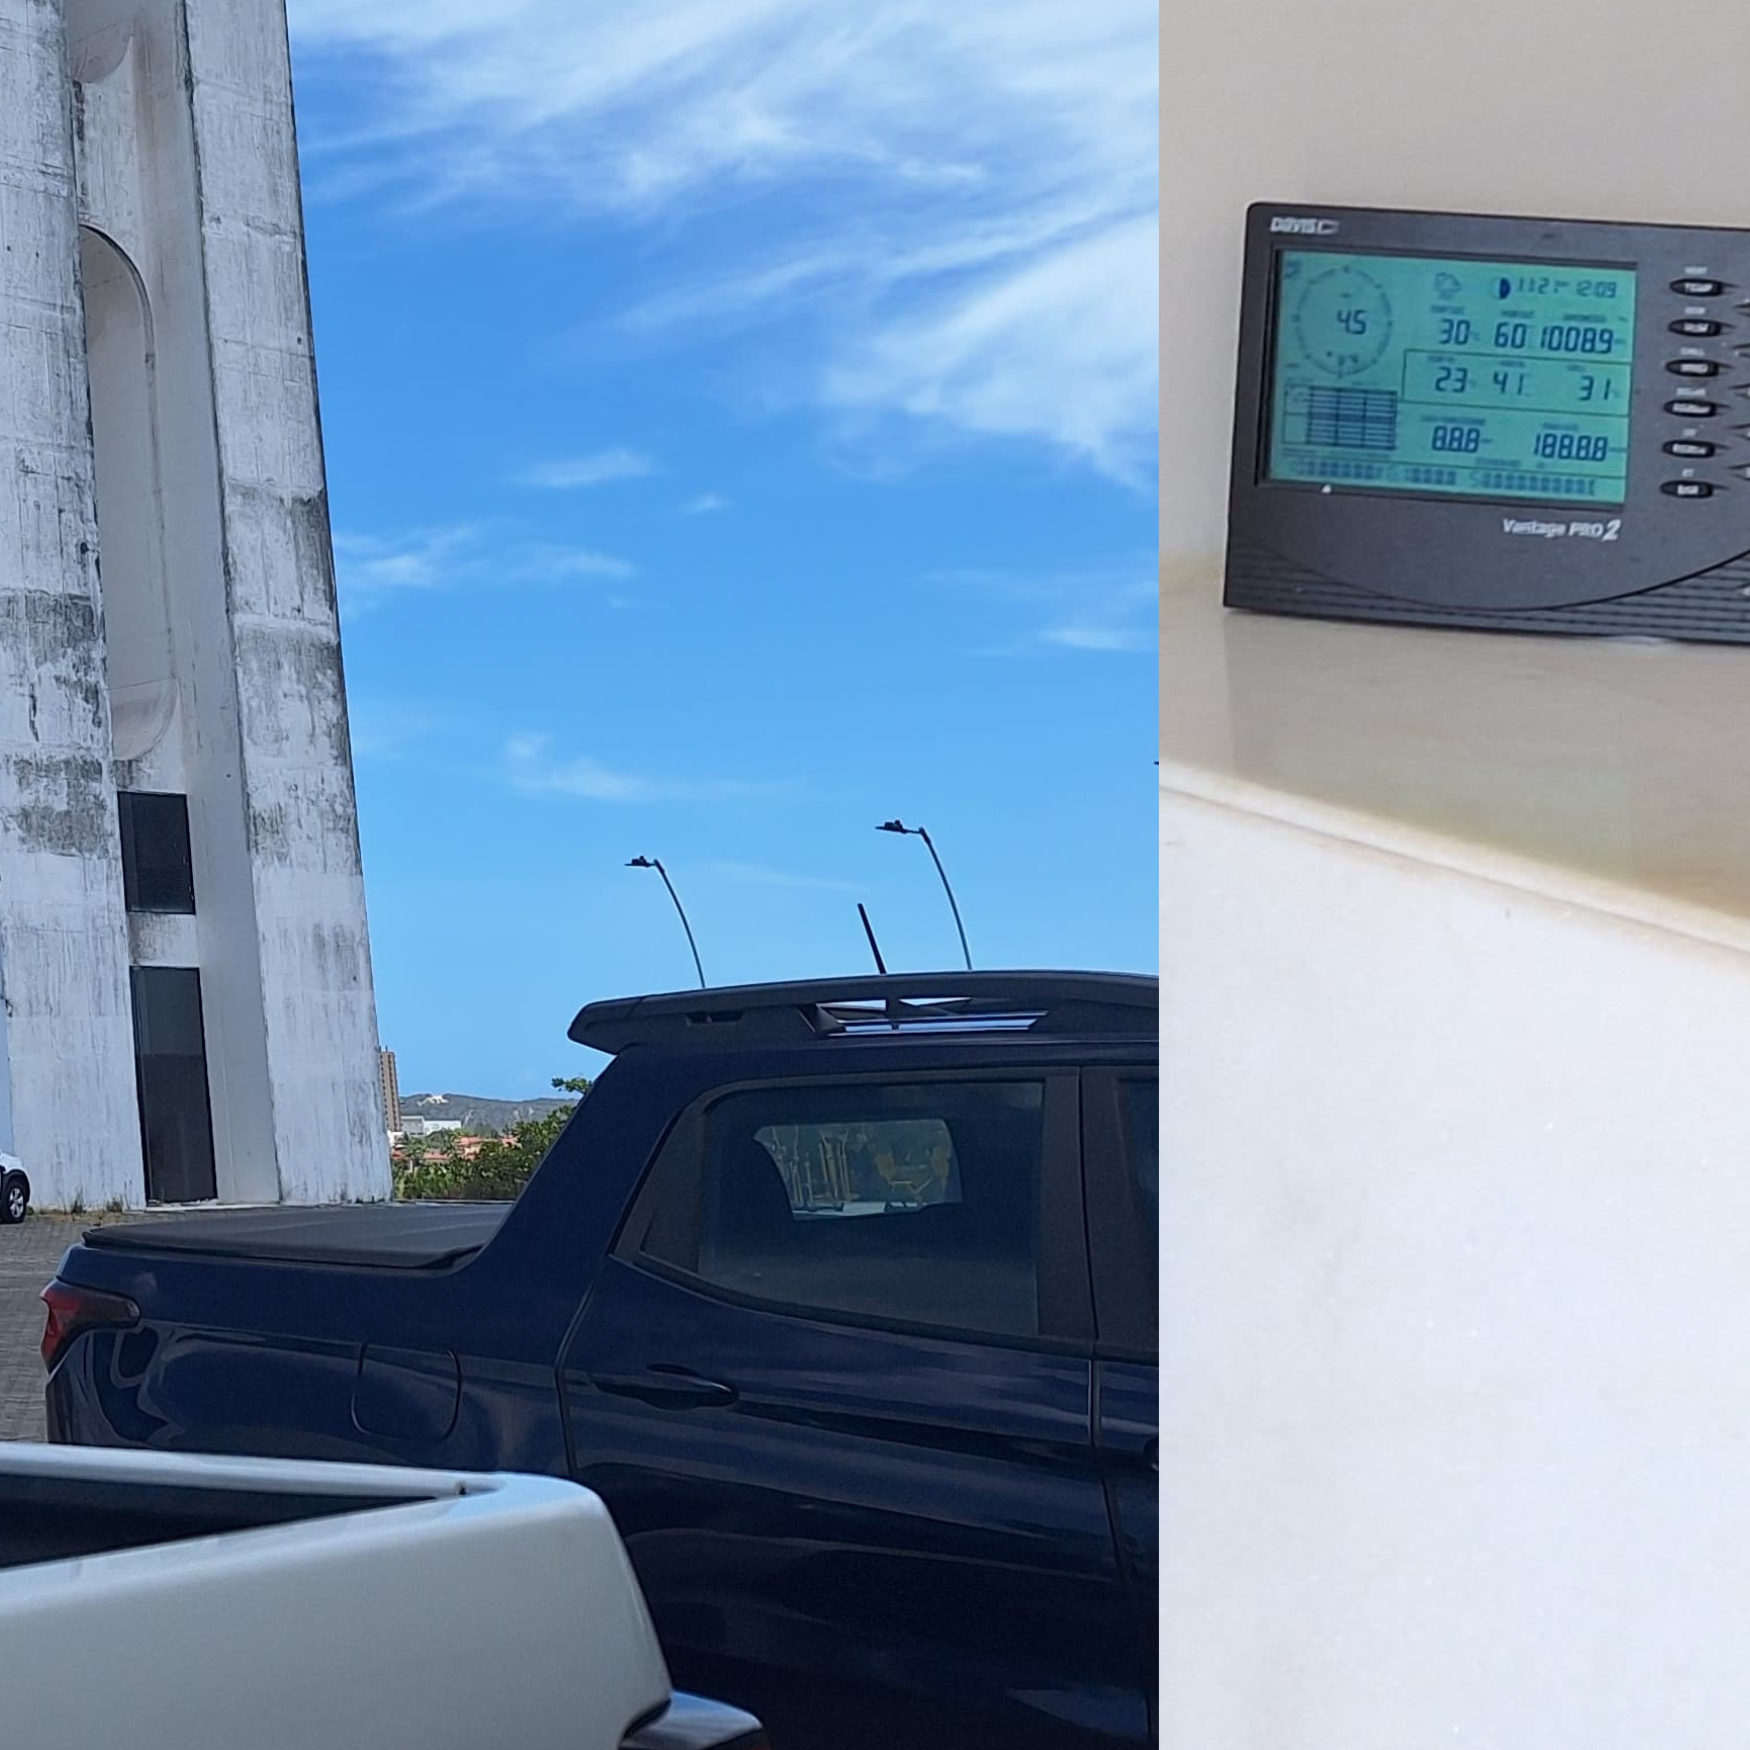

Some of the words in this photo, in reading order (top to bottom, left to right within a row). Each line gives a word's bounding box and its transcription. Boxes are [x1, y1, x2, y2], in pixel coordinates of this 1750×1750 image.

[1336, 308, 1367, 335] 45
[1439, 319, 1470, 345] 30
[1494, 323, 1526, 349] 60
[1436, 367, 1468, 393] 23
[1492, 371, 1524, 397] 41
[1579, 376, 1611, 401] 31
[1502, 519, 1566, 537] Vantage
